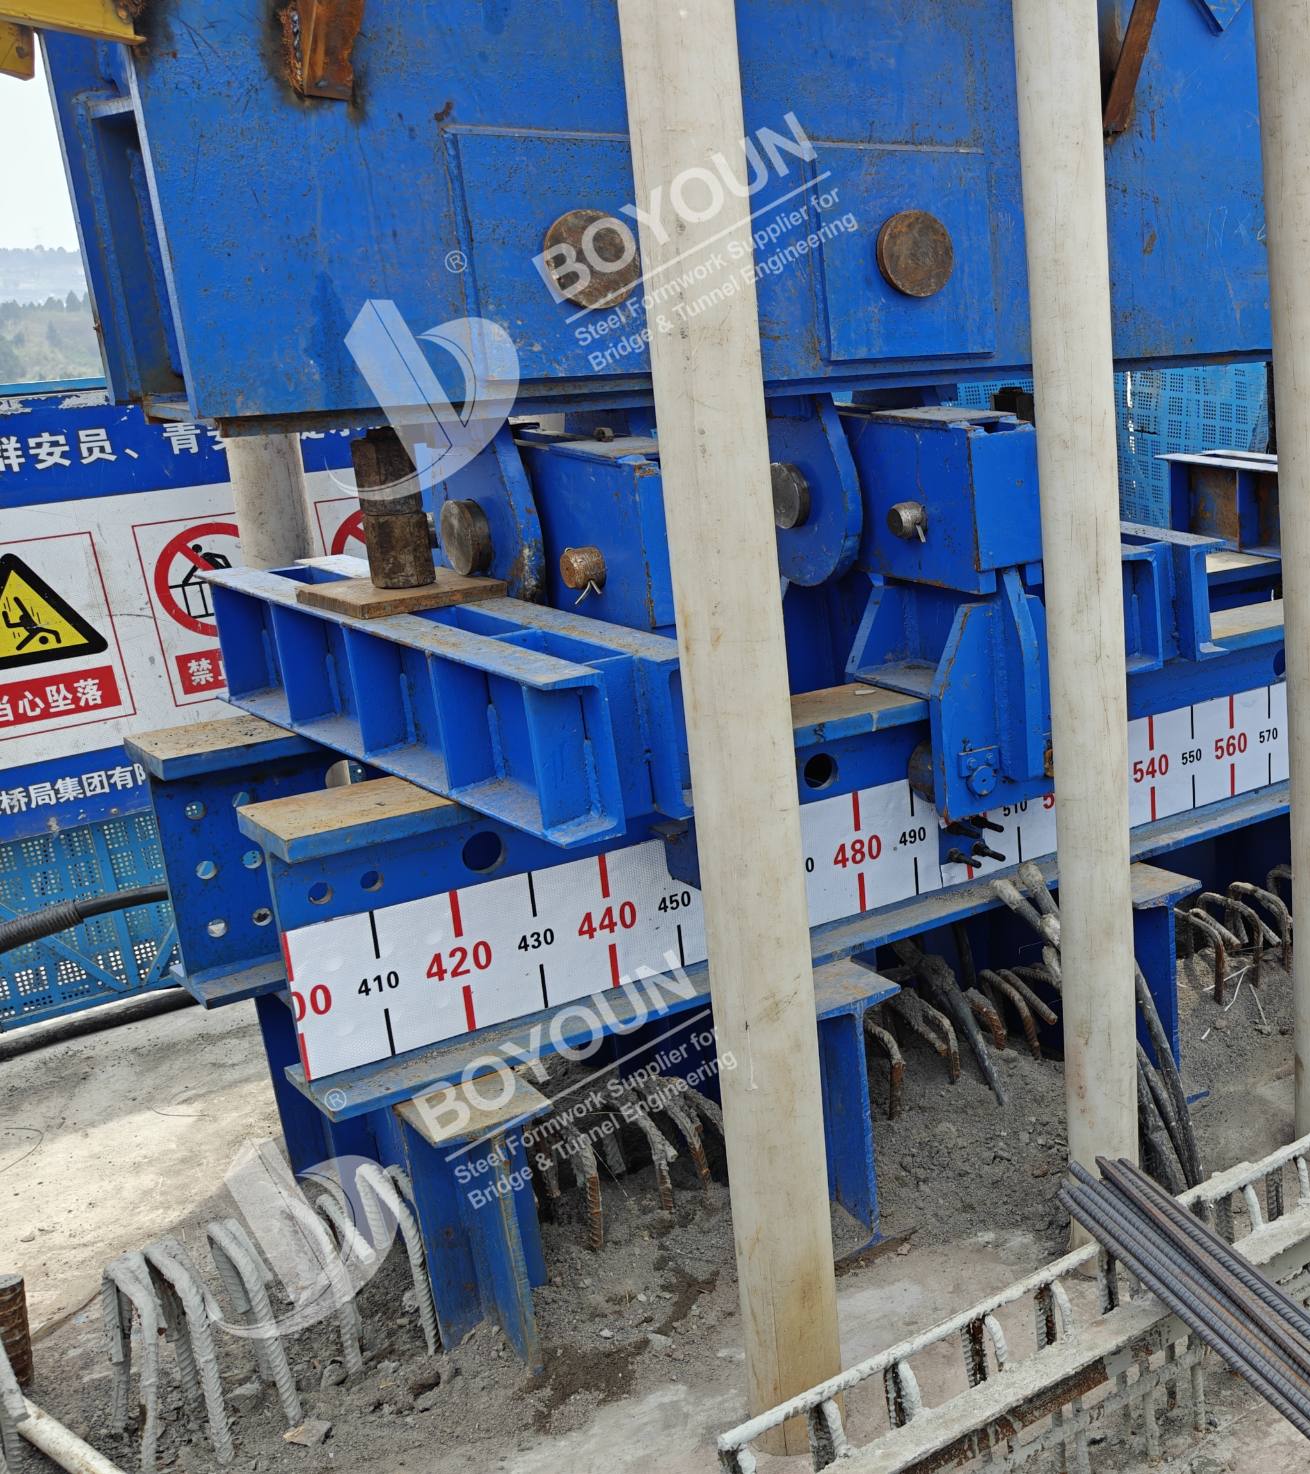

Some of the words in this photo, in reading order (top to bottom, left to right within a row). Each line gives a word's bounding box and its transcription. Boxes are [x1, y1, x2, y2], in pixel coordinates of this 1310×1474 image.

[358, 970, 400, 997] 410
[426, 940, 493, 983] 420
[518, 928, 554, 952] 430
[578, 901, 637, 940] 440
[658, 891, 691, 913] 450
[833, 834, 882, 869] 480
[899, 827, 926, 846] 490
[1133, 754, 1169, 784] 540
[1182, 748, 1202, 766] 550
[1214, 732, 1247, 760] 560
[1259, 727, 1278, 744] 570
